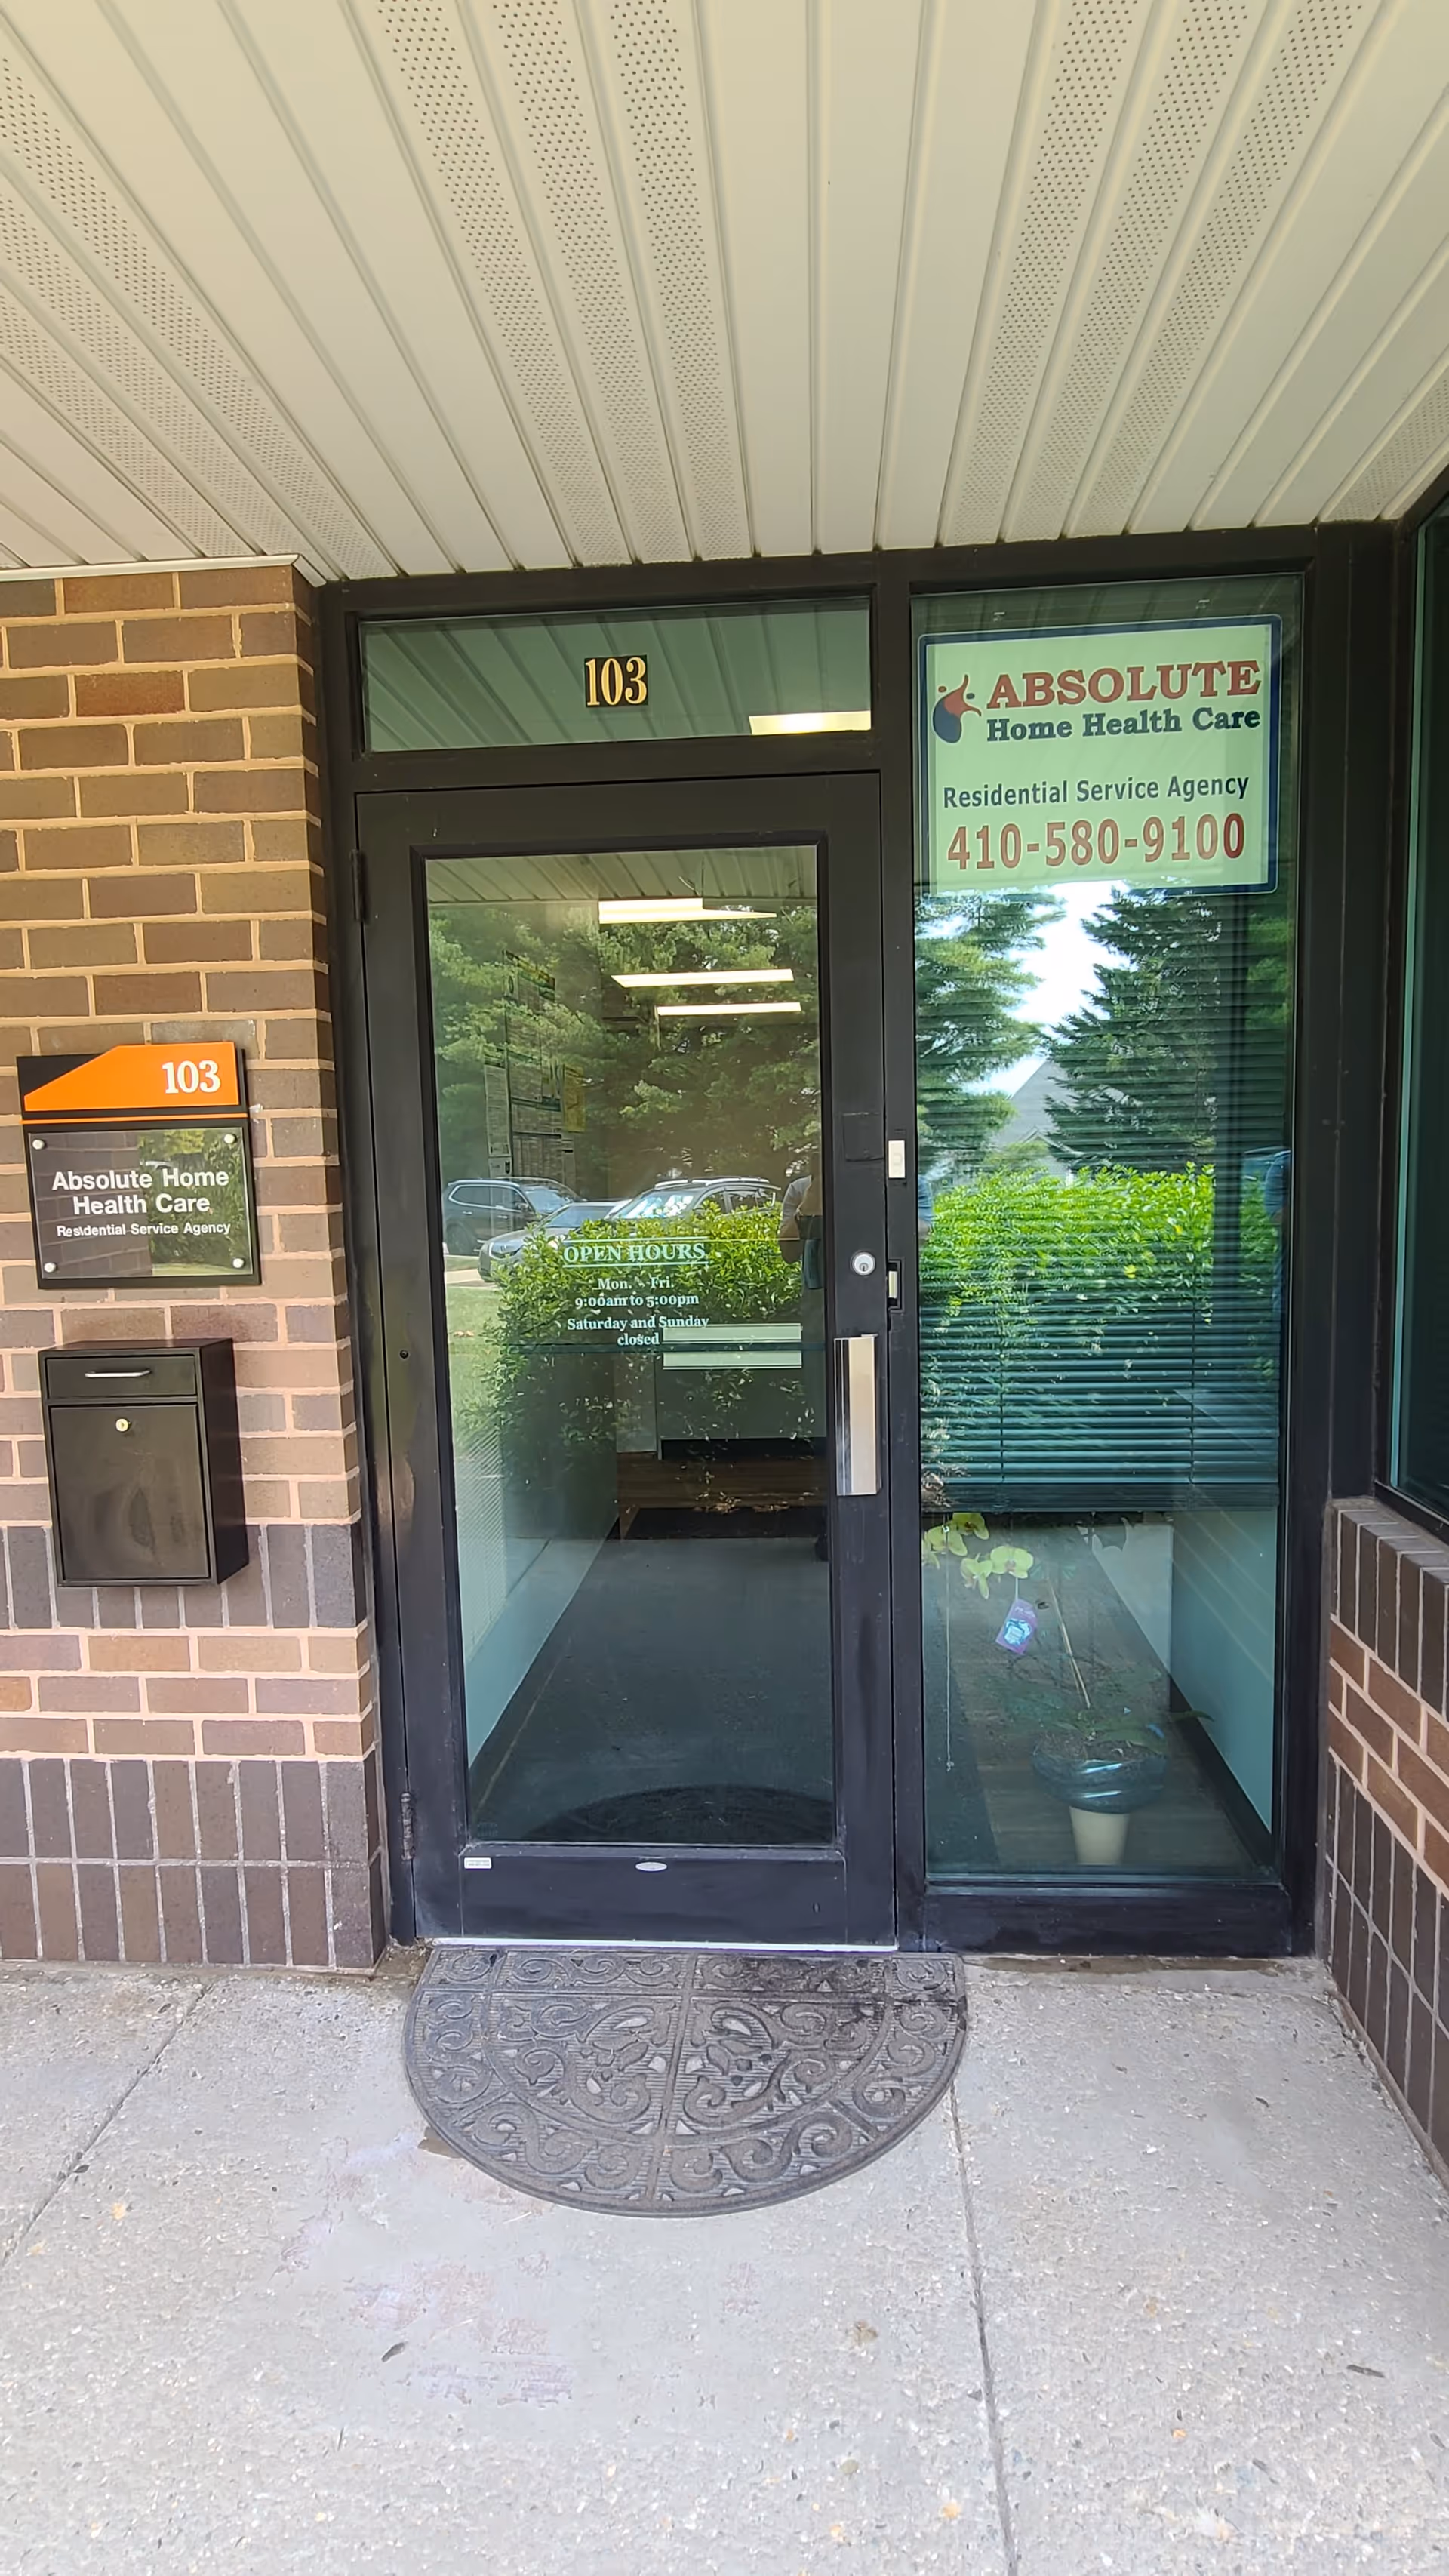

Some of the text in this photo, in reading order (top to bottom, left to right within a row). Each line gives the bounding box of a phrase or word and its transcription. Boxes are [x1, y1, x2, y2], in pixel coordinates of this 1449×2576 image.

[585, 657, 647, 706] 103
[986, 660, 1262, 709] ABSOLUTE
[986, 707, 1261, 742] Home Health Care
[943, 776, 1249, 808] Residential Service Agency
[948, 813, 1245, 870] 410-580-9100
[162, 1060, 221, 1094] 103
[52, 1168, 229, 1190] Absolute Home
[73, 1193, 210, 1214] Health Care
[57, 1222, 231, 1236] Residential Service Agency
[564, 1242, 706, 1263] OPEN HOURS
[597, 1276, 674, 1290] Mon. Fri.
[575, 1295, 699, 1310] 9:00am to 5:00pm
[567, 1315, 709, 1331] Saturday and Sunday
[617, 1332, 660, 1346] closed
